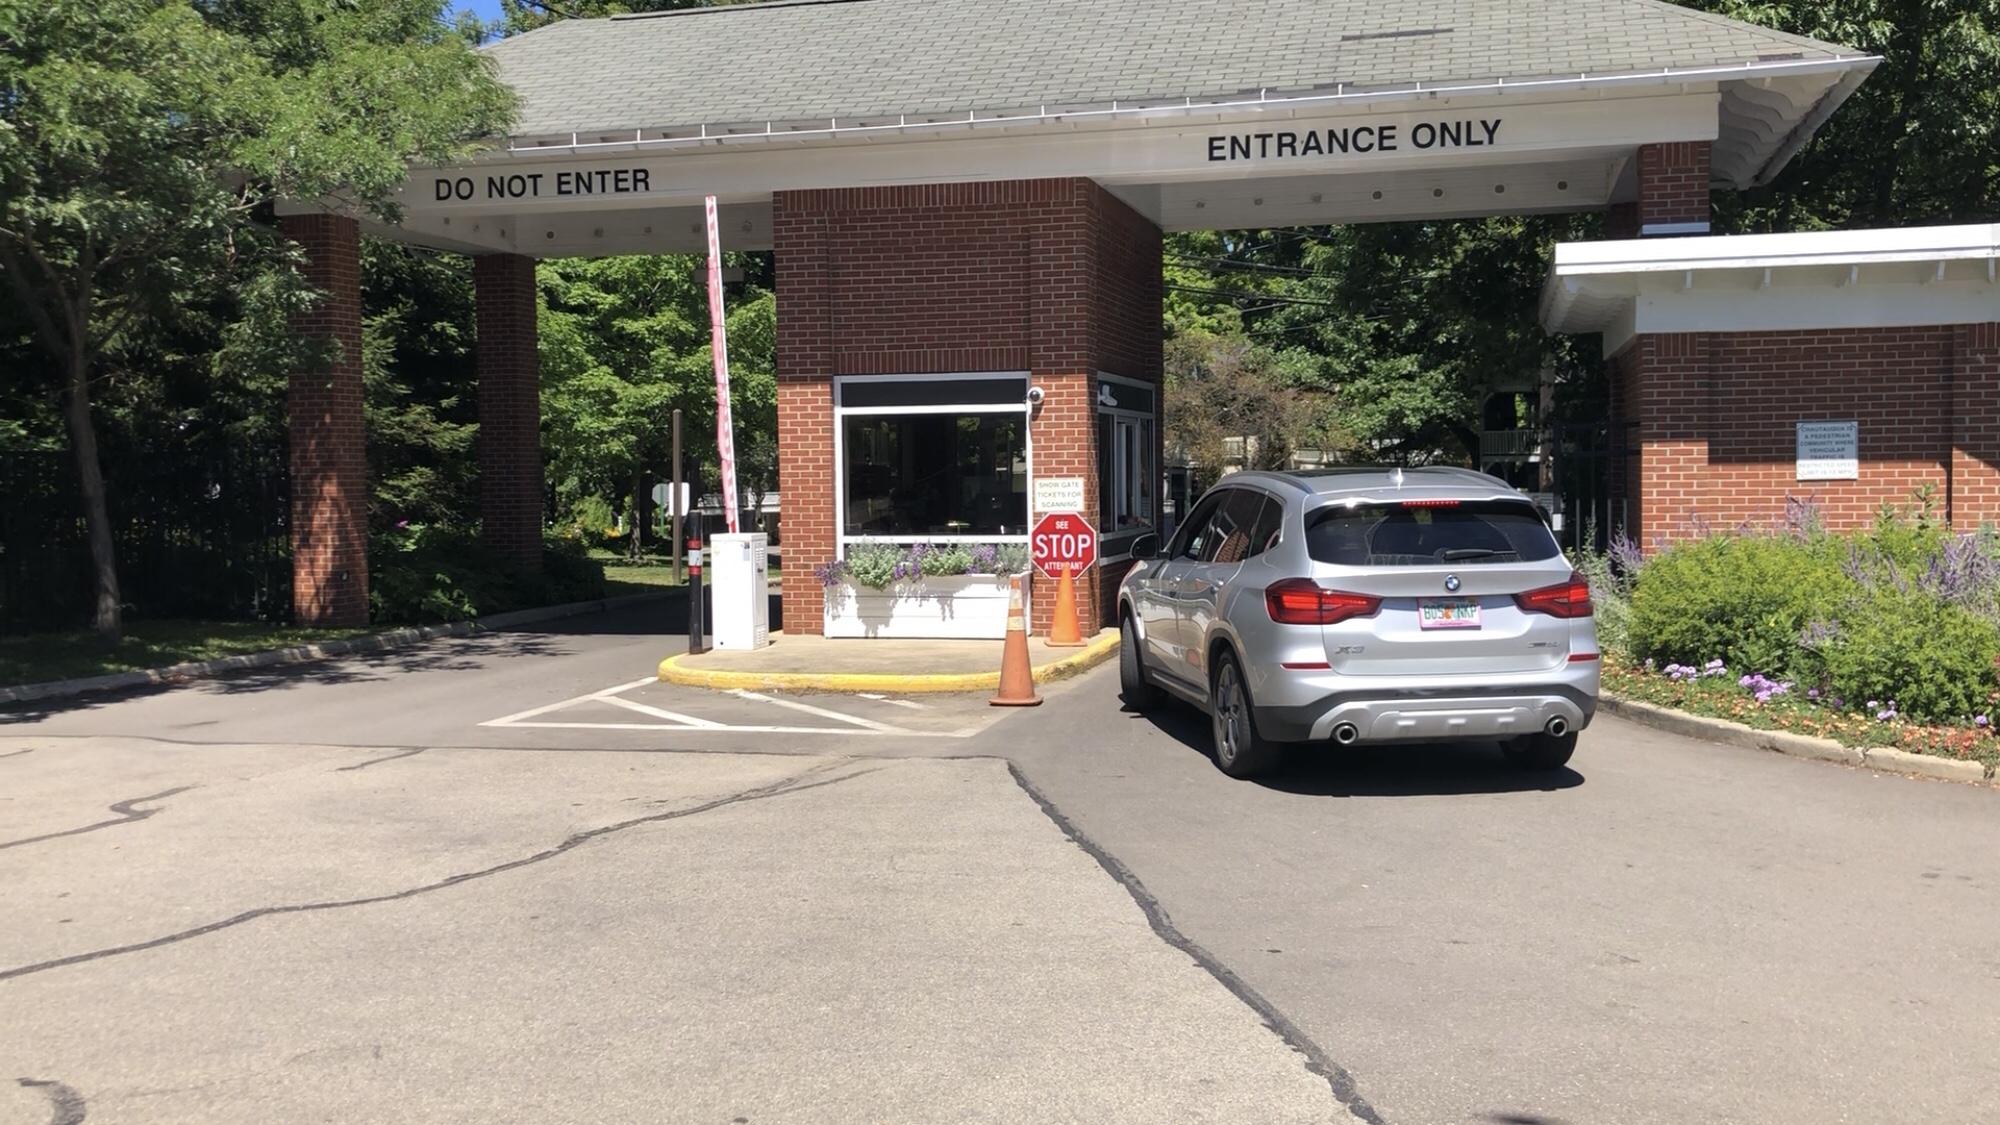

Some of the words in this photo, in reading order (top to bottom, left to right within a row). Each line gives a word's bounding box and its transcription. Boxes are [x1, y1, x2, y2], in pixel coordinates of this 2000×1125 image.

[1207, 125, 1397, 161] ENTRANCE
[1411, 119, 1502, 149] ONLY
[435, 177, 474, 200] DO
[488, 174, 543, 198] NOT
[556, 168, 650, 195] ENTER
[1055, 521, 1069, 529] SEE
[1035, 534, 1091, 558] STOP
[1044, 562, 1083, 570] ATTENANT
[1334, 645, 1365, 654] X3
